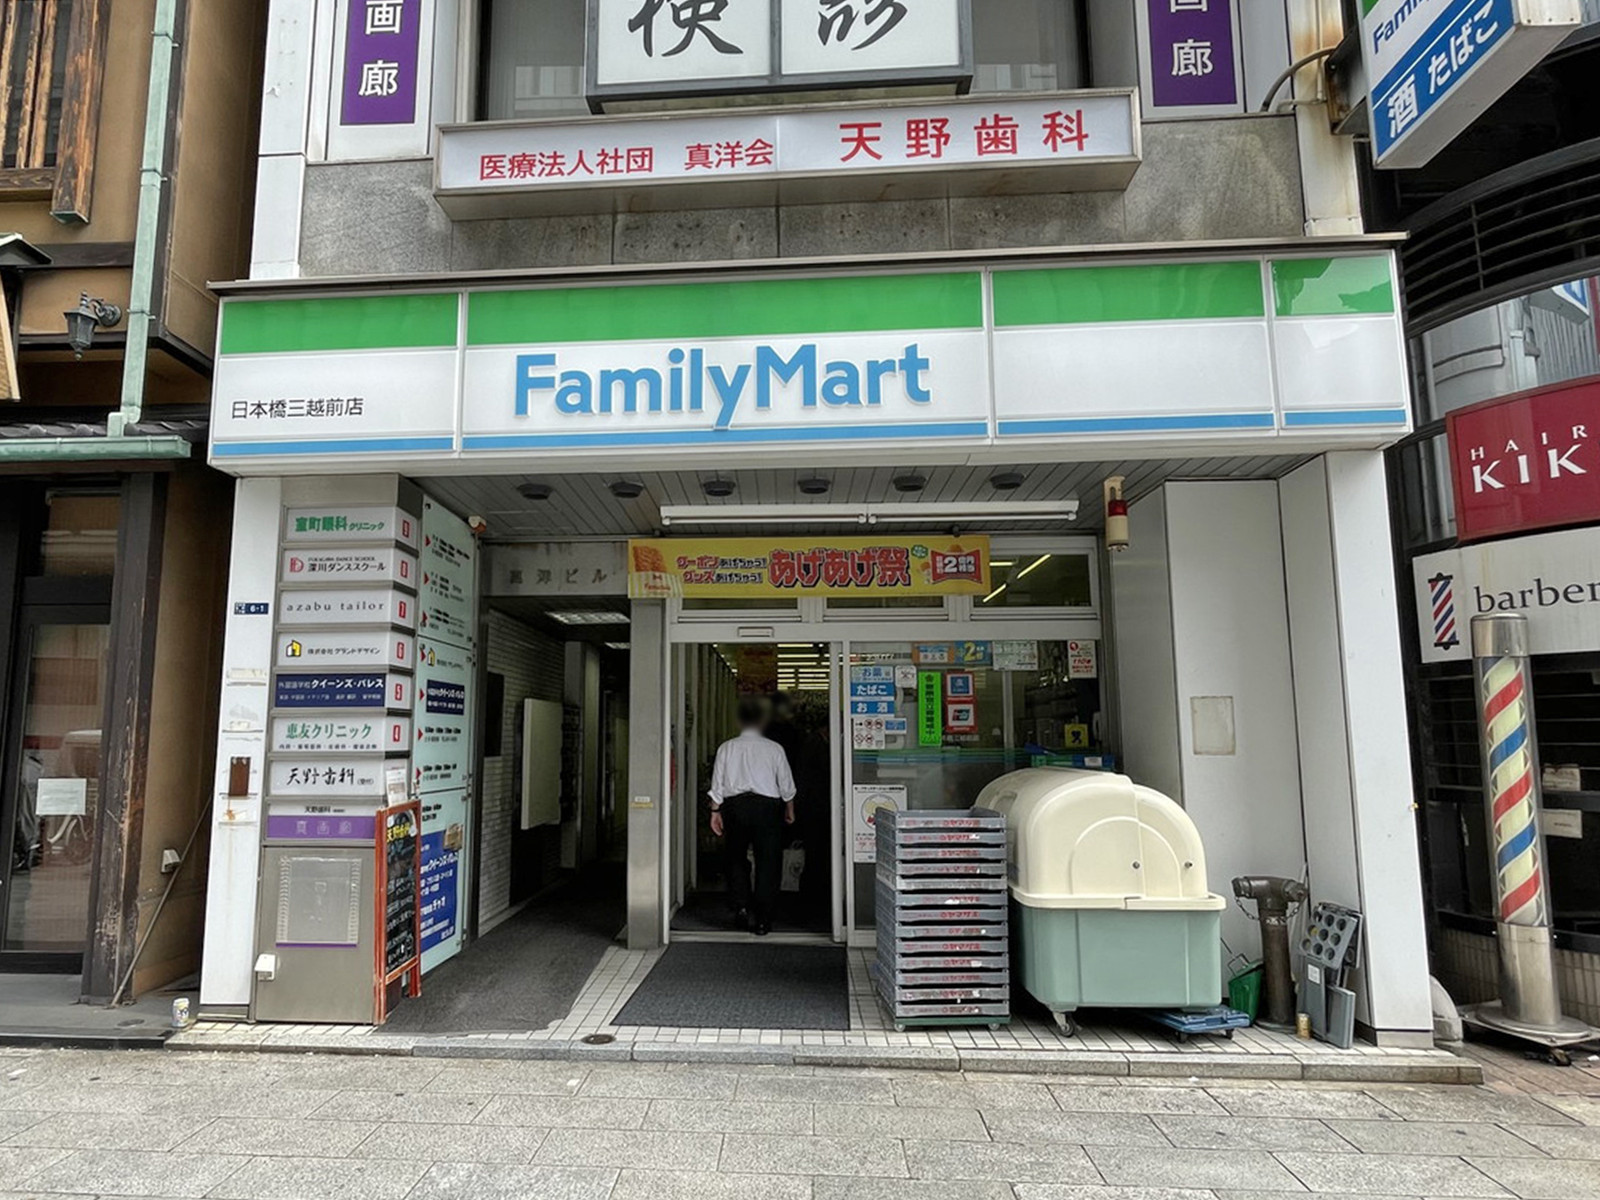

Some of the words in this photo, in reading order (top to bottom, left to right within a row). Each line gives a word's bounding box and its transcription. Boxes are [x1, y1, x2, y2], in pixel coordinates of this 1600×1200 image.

[1387, 74, 1419, 139] 酒
[1428, 0, 1499, 95] たばこ
[479, 146, 654, 182] 医療法人社団
[684, 139, 775, 172] 真洋会
[840, 109, 1090, 163] 天野歯科
[513, 342, 932, 431] FamilyMart
[230, 397, 365, 420] 日本橋三越前店
[1470, 424, 1588, 461] HAIR
[1472, 443, 1588, 494] KIK
[308, 562, 387, 573] 深川ダンススクール
[767, 546, 912, 589] あげあげ祭
[286, 601, 332, 612] azabu
[341, 600, 385, 611] tailor
[1473, 577, 1600, 614] barber
[856, 684, 888, 696] たばこ
[856, 702, 888, 713] お酒
[285, 722, 373, 740] 恵友クリニック
[286, 766, 355, 786] 天野歯科
